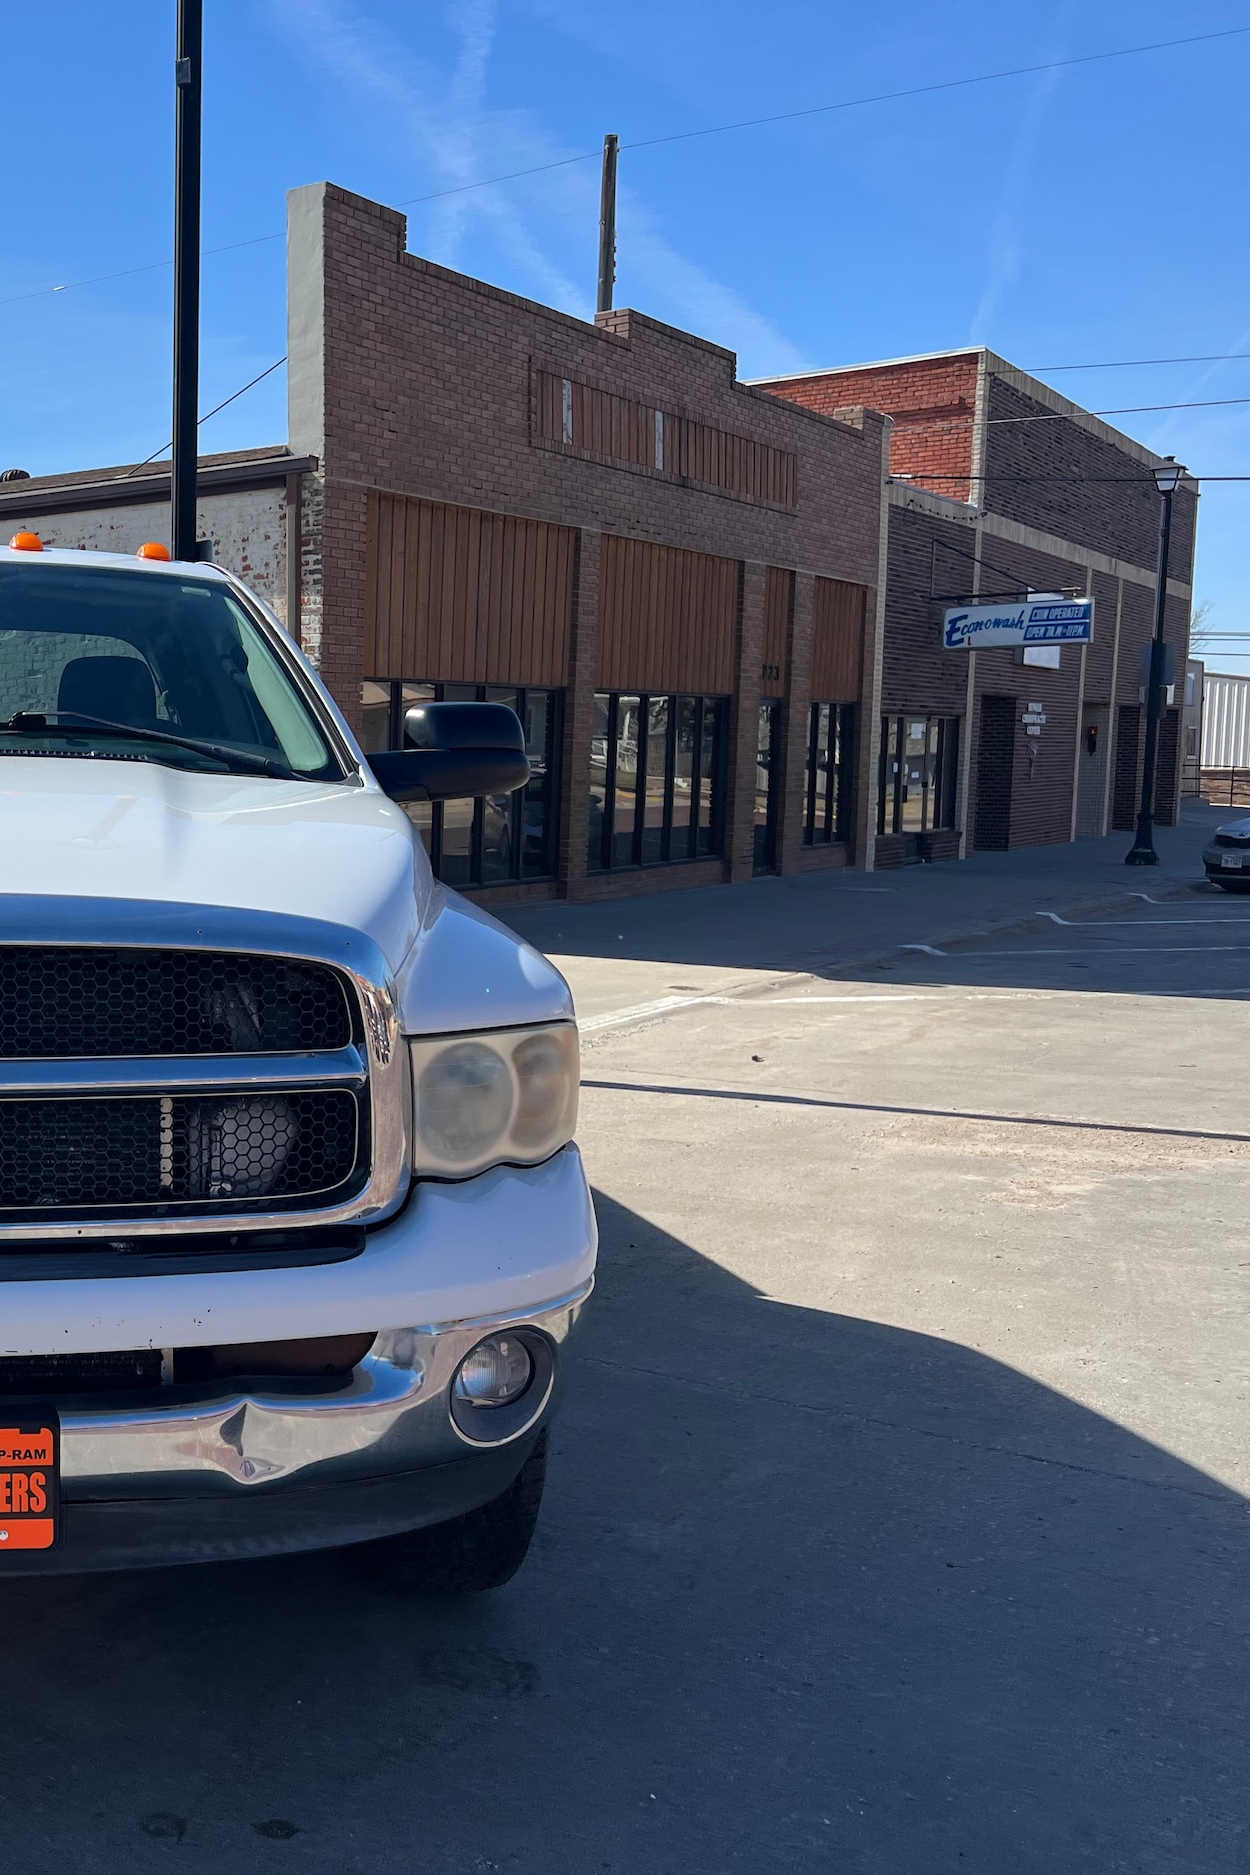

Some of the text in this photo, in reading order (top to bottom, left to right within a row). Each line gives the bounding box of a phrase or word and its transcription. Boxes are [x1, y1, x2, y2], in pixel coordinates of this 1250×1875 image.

[1049, 606, 1084, 619] OPERATED
[945, 610, 1026, 647] Econowash
[1026, 626, 1045, 638] OPEN
